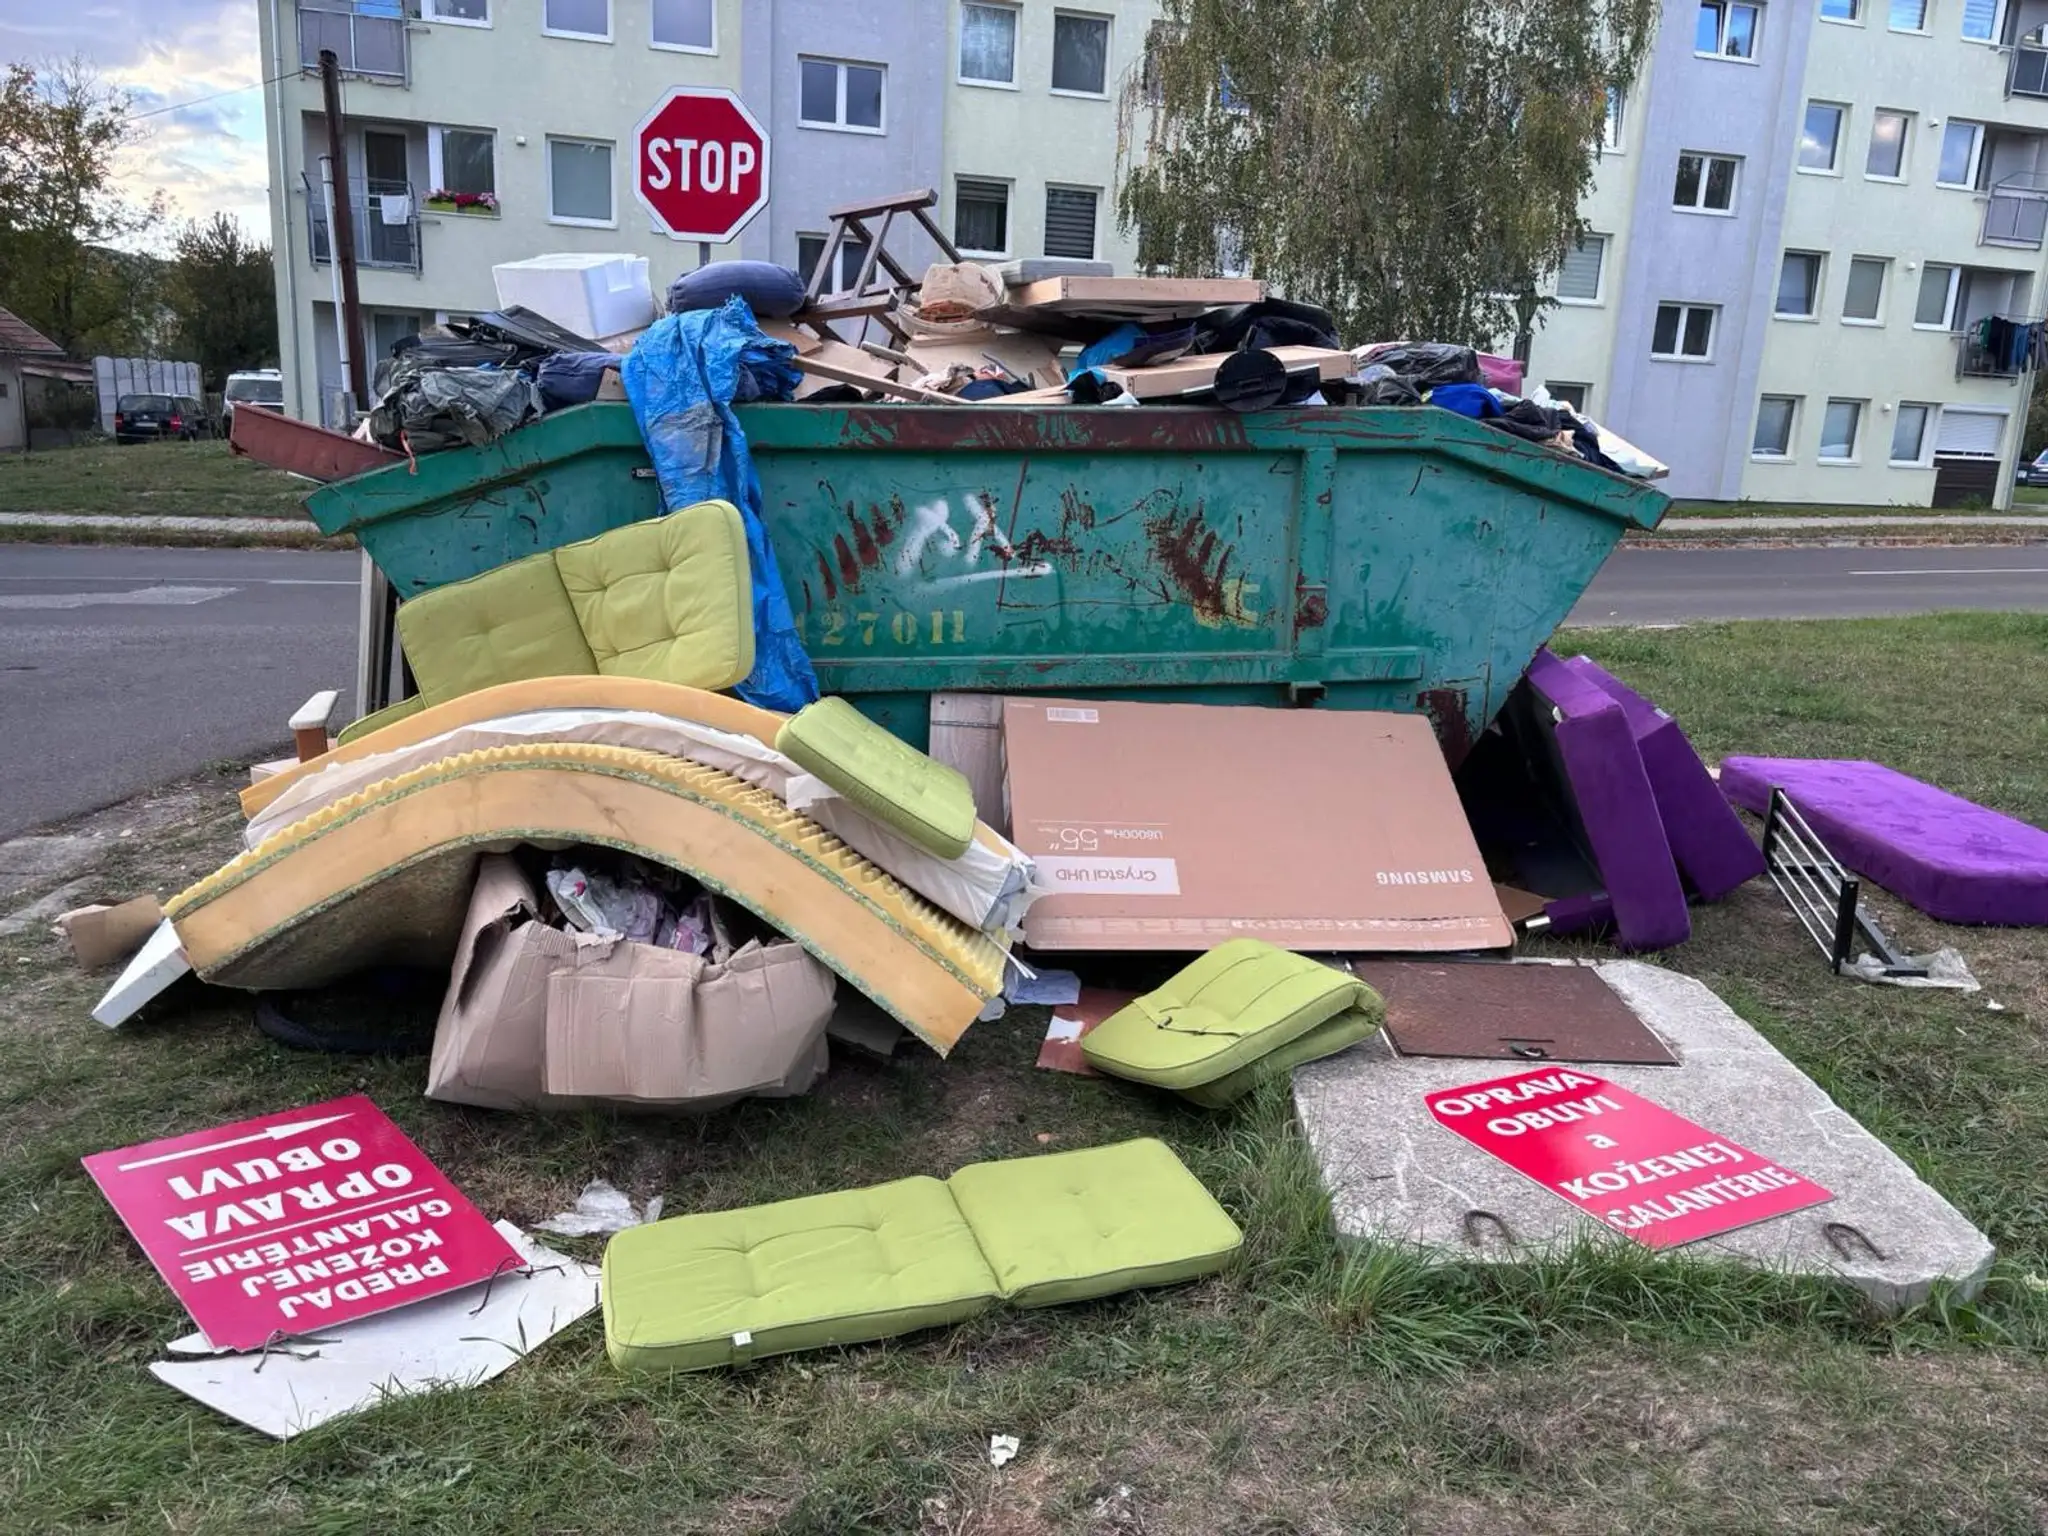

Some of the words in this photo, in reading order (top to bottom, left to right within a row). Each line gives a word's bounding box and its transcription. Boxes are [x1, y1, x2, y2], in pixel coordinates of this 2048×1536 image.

[647, 137, 755, 195] STOP
[1055, 868, 1089, 882] UHD
[1092, 866, 1157, 882] Crystal
[1376, 869, 1474, 885] SAMSUNG
[1435, 1071, 1598, 1116] OPRAVA
[1486, 1095, 1623, 1137] OBUVI
[166, 1137, 362, 1200] OBUVI
[1585, 1133, 1619, 1149] a
[1558, 1141, 1744, 1200] KOŽENEJ
[1606, 1166, 1800, 1230] GALANTÉRIE
[164, 1163, 413, 1241] OPRAVA
[181, 1199, 452, 1283] GALANTÉRIE
[241, 1228, 444, 1297] KOŽENEJ
[278, 1254, 451, 1319] PREDAJ
